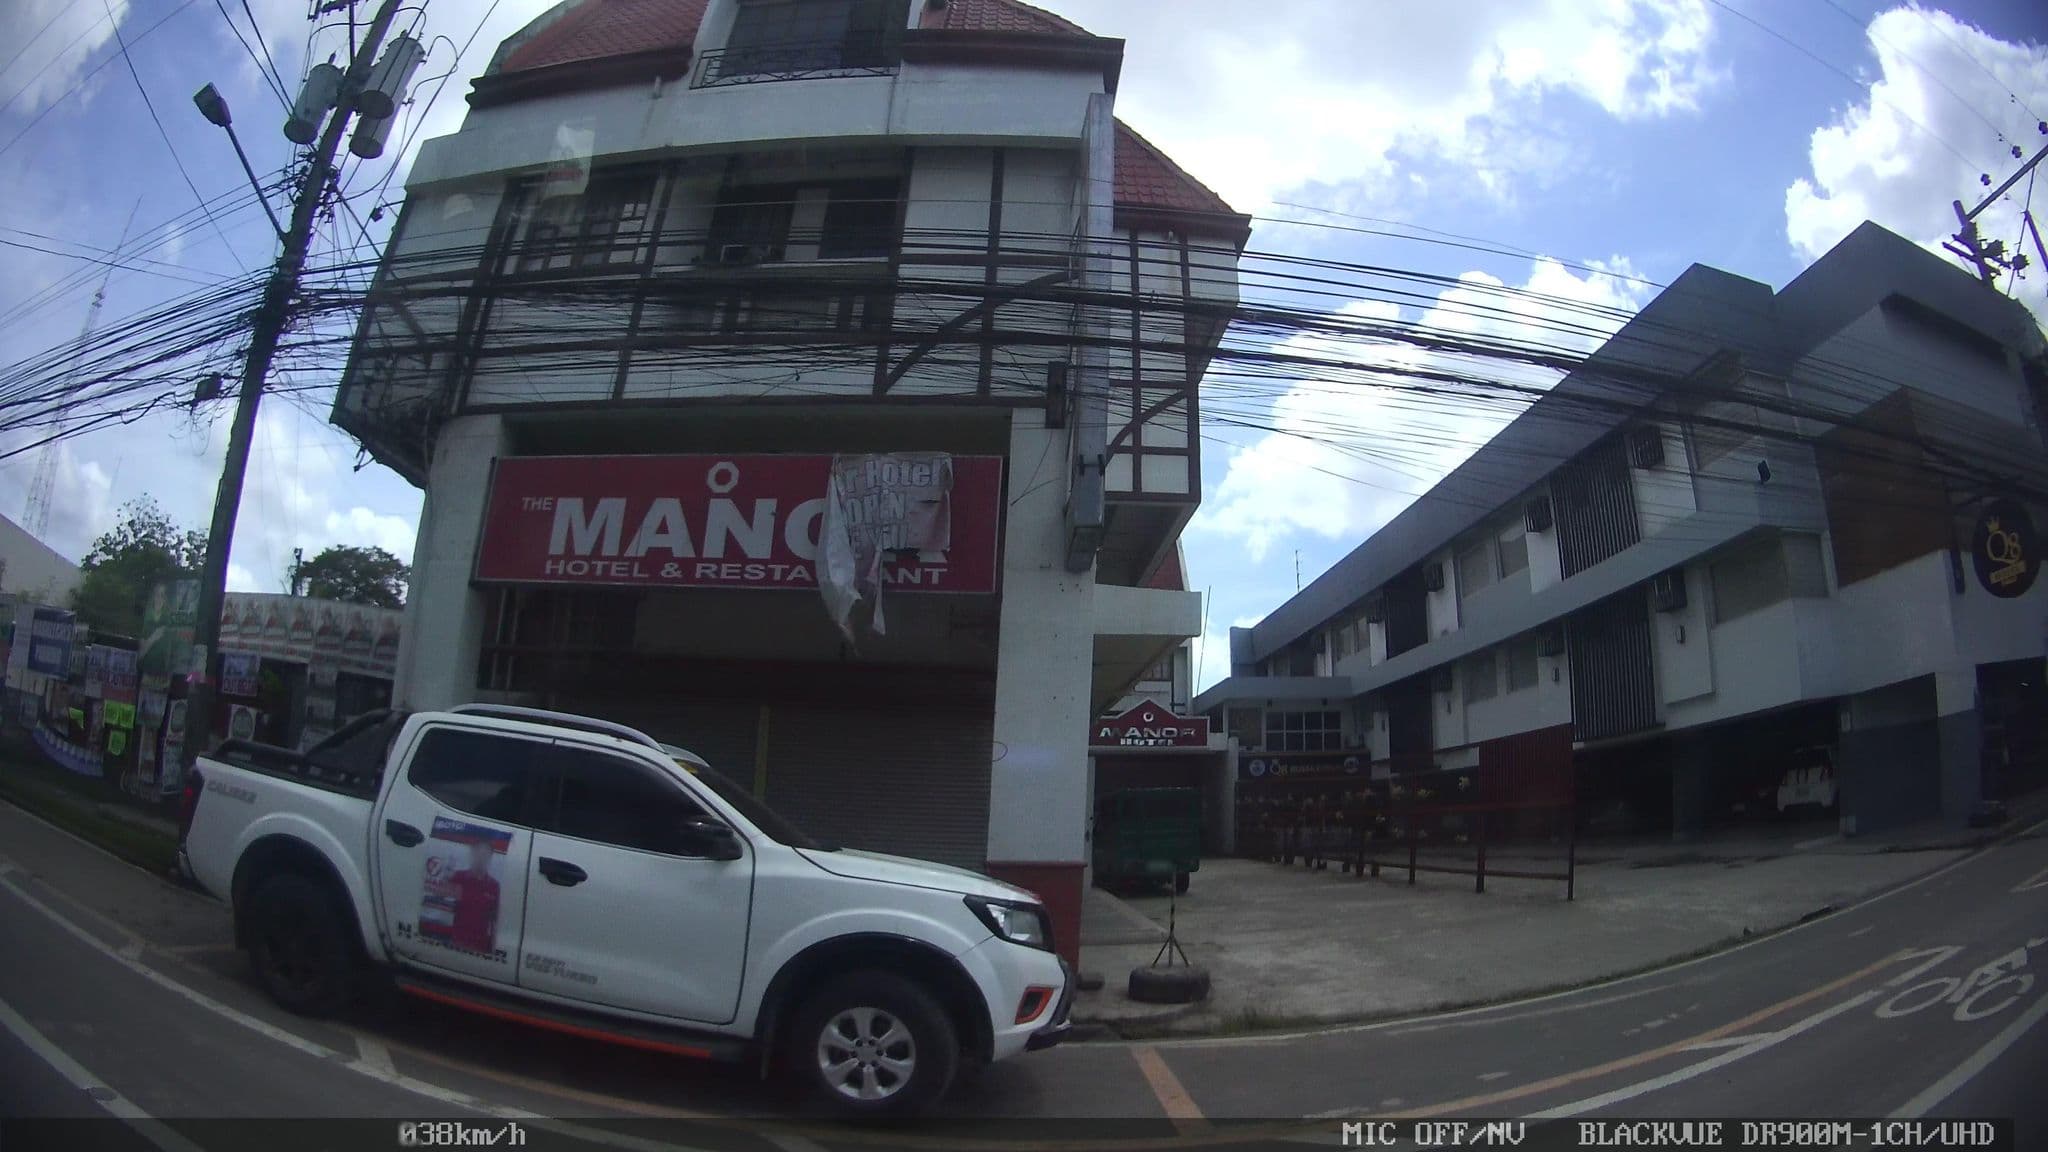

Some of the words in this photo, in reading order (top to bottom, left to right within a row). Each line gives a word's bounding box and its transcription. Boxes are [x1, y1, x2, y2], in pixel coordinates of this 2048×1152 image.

[520, 496, 552, 512] THE
[545, 560, 649, 579] HOTEL
[659, 562, 683, 579] &
[695, 563, 948, 586] RESTAANT
